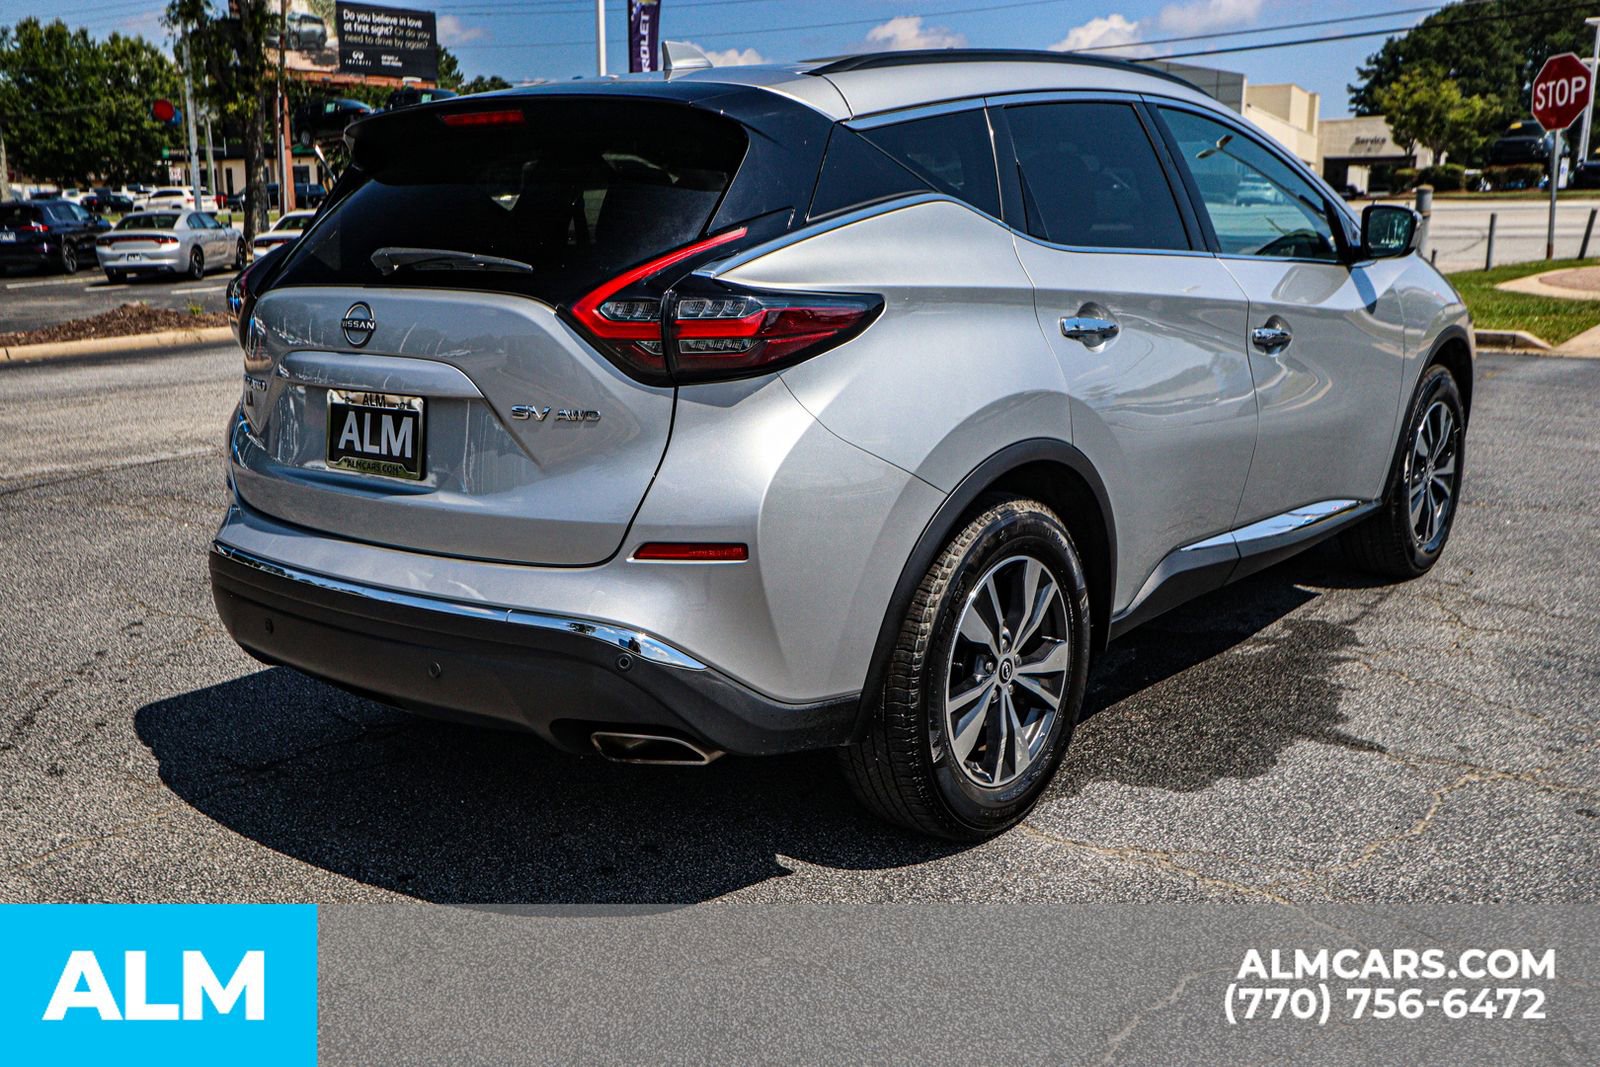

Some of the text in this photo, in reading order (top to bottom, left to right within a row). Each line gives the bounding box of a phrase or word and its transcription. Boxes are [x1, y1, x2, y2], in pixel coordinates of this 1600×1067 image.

[343, 8, 422, 28] Do you believe in love
[344, 22, 352, 32] at
[354, 22, 369, 33] first
[371, 24, 393, 36] sight?
[405, 29, 415, 37] do
[417, 31, 430, 39] you
[345, 34, 428, 50] need to drive by again?
[1535, 76, 1587, 111] STOP
[1355, 136, 1386, 145] Service
[342, 319, 376, 331] NISSAN
[362, 394, 386, 408] ALM
[511, 404, 601, 422] SV AWD
[338, 411, 414, 459] ALM
